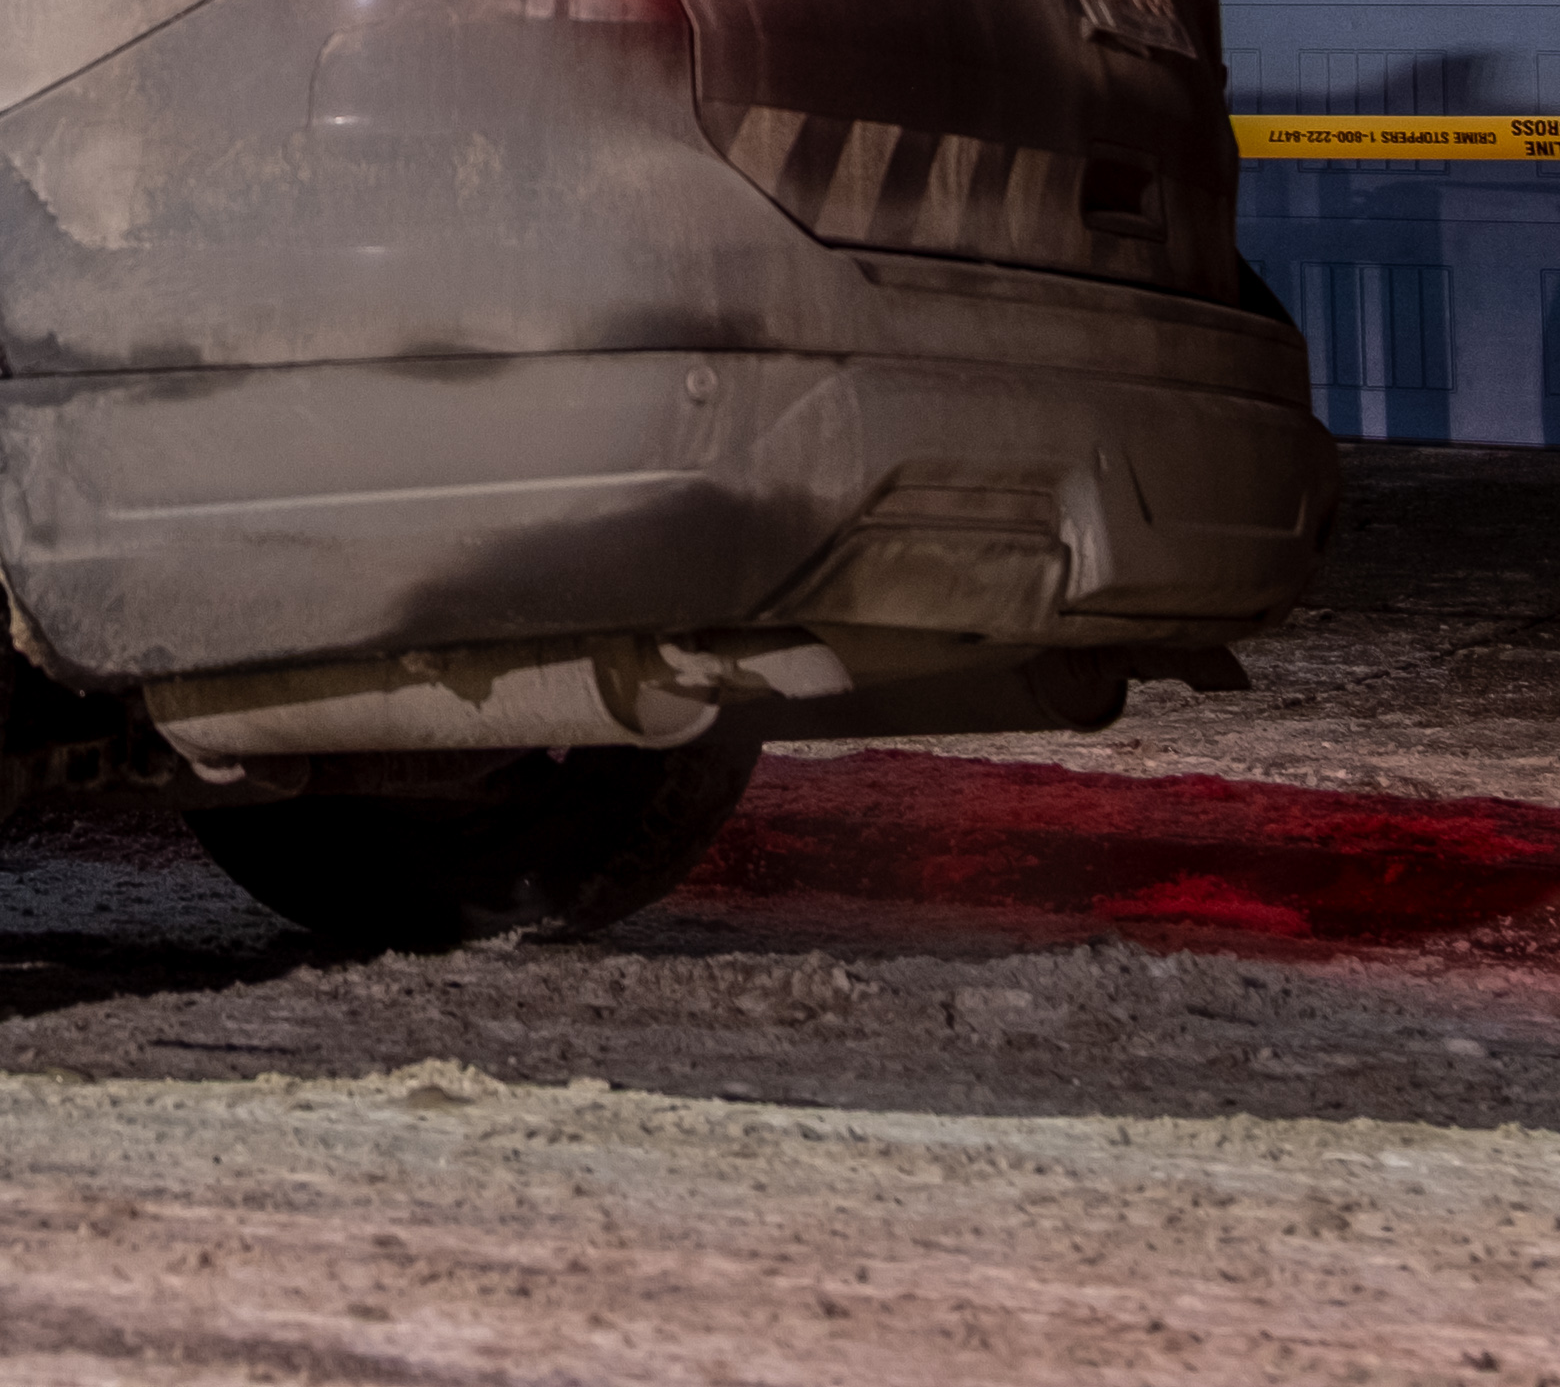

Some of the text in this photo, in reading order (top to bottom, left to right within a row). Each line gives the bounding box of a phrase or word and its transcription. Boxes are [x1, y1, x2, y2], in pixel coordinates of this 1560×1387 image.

[1268, 129, 1497, 146] CRIME STOPPERS 1-800-222-8477
